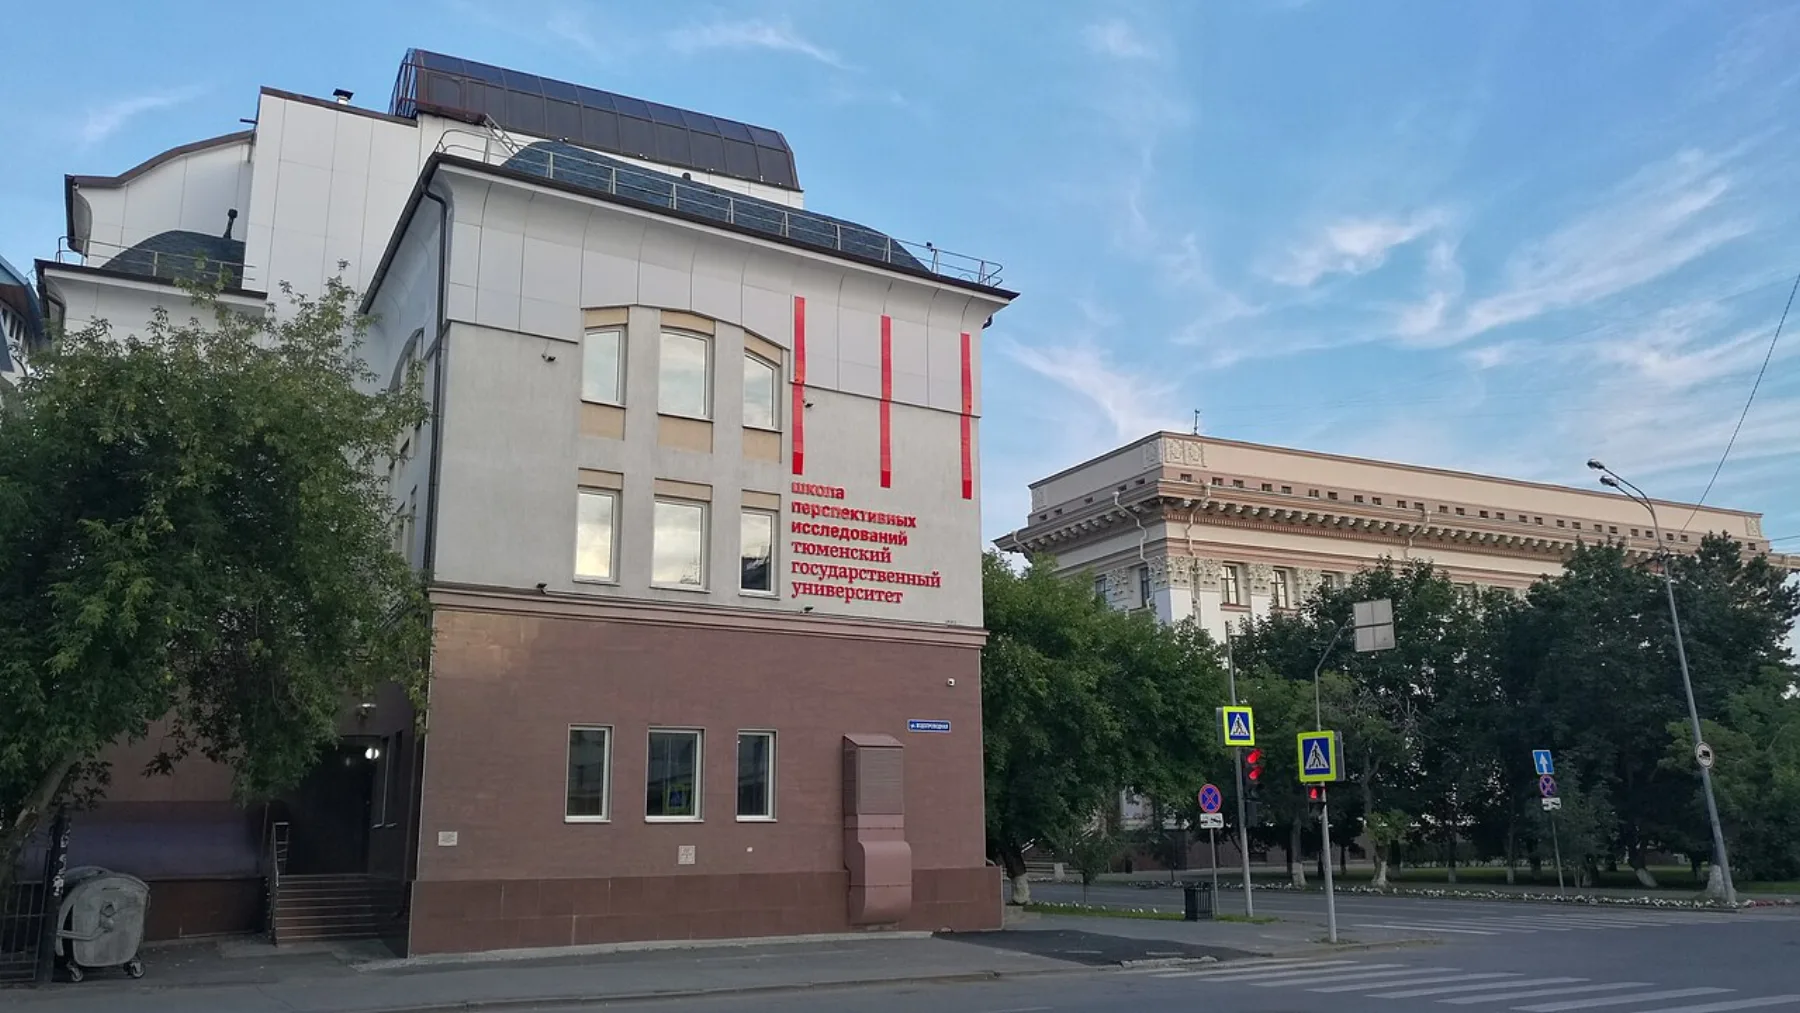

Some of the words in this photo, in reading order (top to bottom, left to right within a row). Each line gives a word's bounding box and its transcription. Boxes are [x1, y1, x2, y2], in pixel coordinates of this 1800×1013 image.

[791, 482, 844, 499] школа
[791, 501, 916, 528] перспективных
[791, 521, 908, 546] исследований
[791, 541, 891, 563] тюменский
[791, 561, 941, 588] государственный
[791, 581, 903, 603] университет
